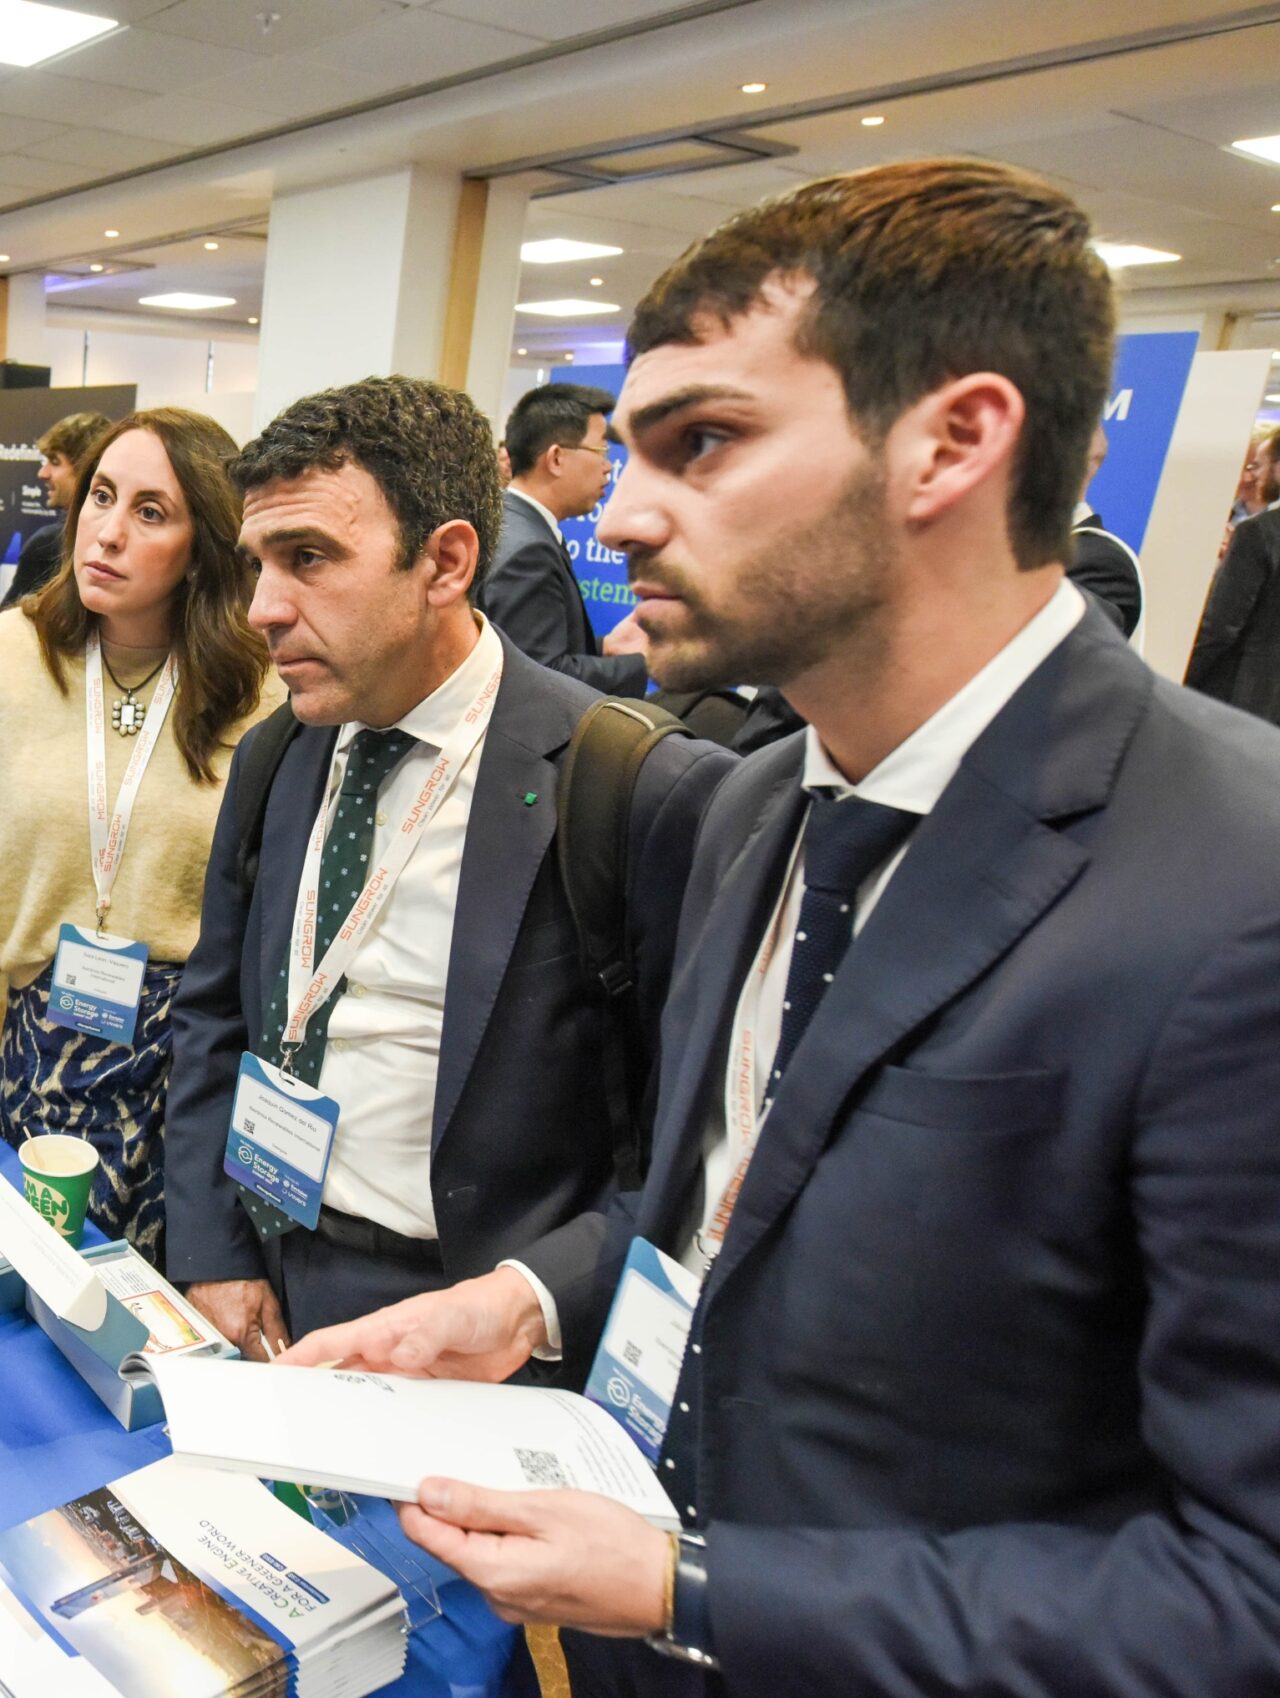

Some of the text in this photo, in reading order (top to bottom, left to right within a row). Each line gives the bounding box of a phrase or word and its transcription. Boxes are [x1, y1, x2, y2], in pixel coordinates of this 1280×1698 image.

[586, 536, 626, 565] the
[96, 762, 104, 820] SUNGROW
[402, 758, 450, 833] SUNGROW
[104, 815, 122, 872] SUNGROW
[302, 890, 315, 968] SUNGROW
[339, 867, 388, 942] SUNGROW
[287, 972, 328, 1040] SUNGROW
[252, 1162, 280, 1184] Storage
[253, 1154, 279, 1175] Energy
[40, 1187, 53, 1201] A
[199, 1519, 317, 1612] FOR A GREENER WORLD
[288, 1607, 304, 1618] A
